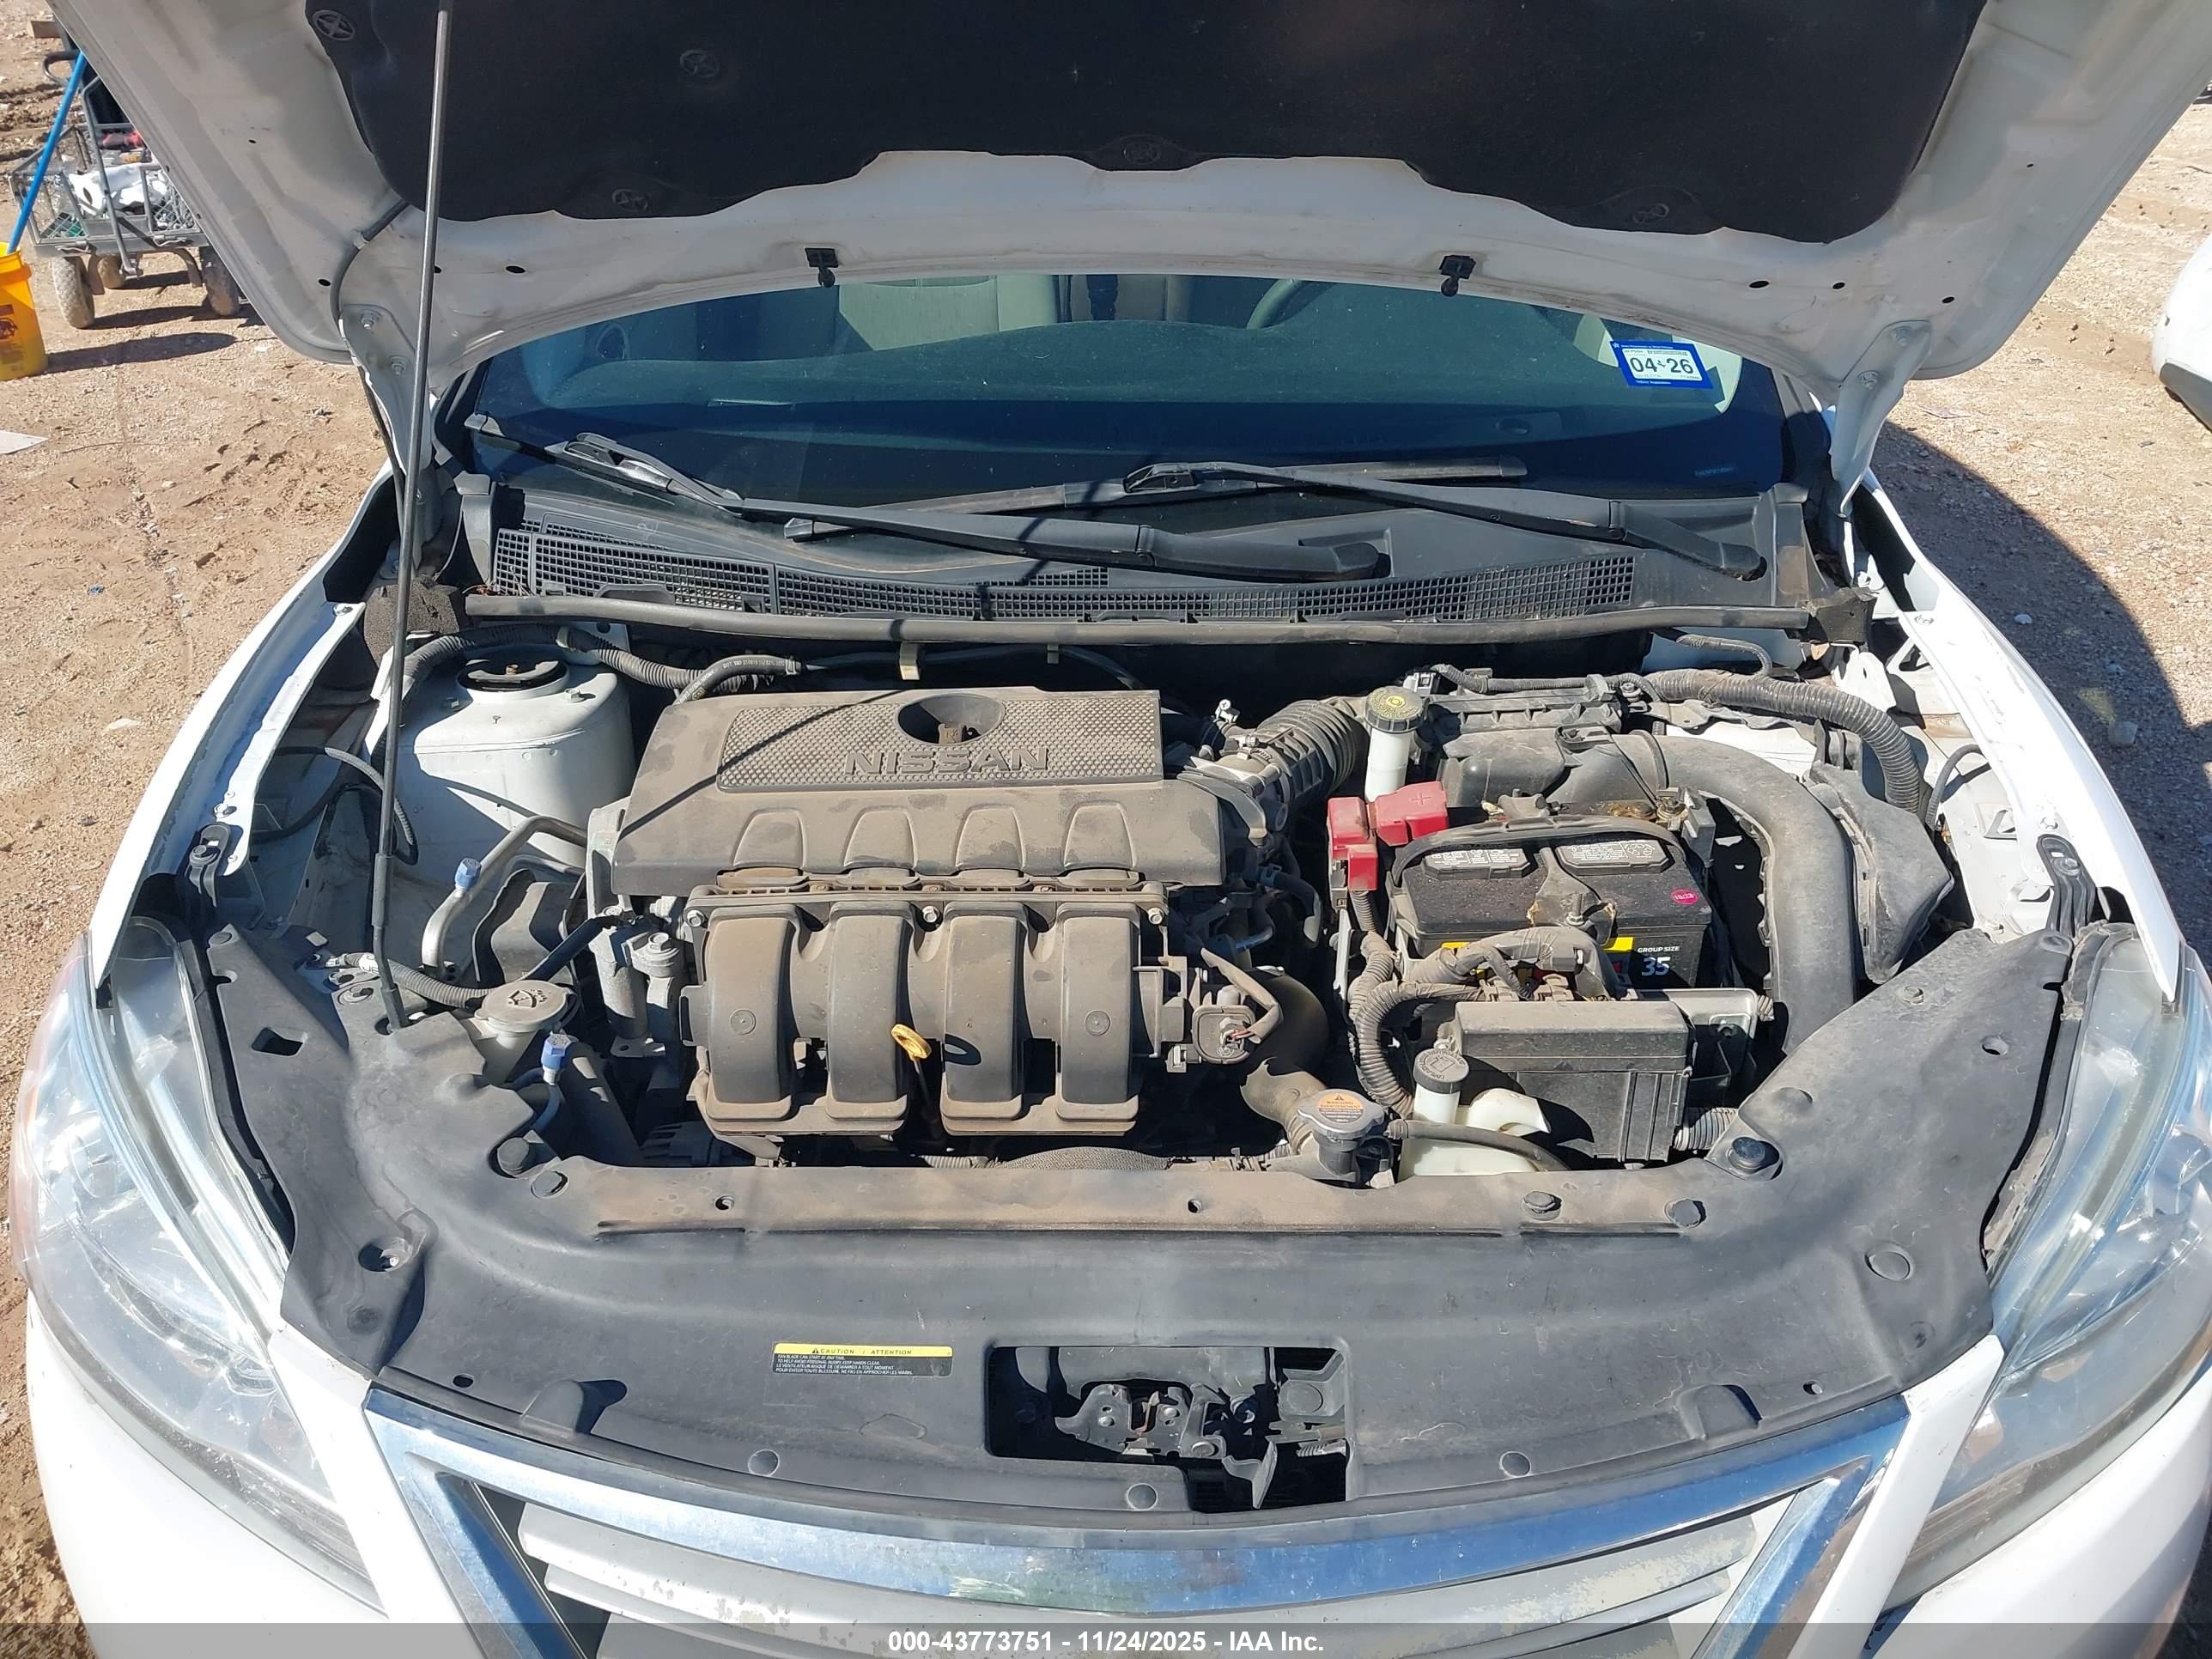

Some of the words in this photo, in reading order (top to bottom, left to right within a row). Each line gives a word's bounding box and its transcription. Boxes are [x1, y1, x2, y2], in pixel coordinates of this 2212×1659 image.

[1630, 357, 1657, 373] 04
[1666, 358, 1694, 374] 26
[843, 748, 1049, 775] NISSAN
[1641, 956, 1671, 976] 35
